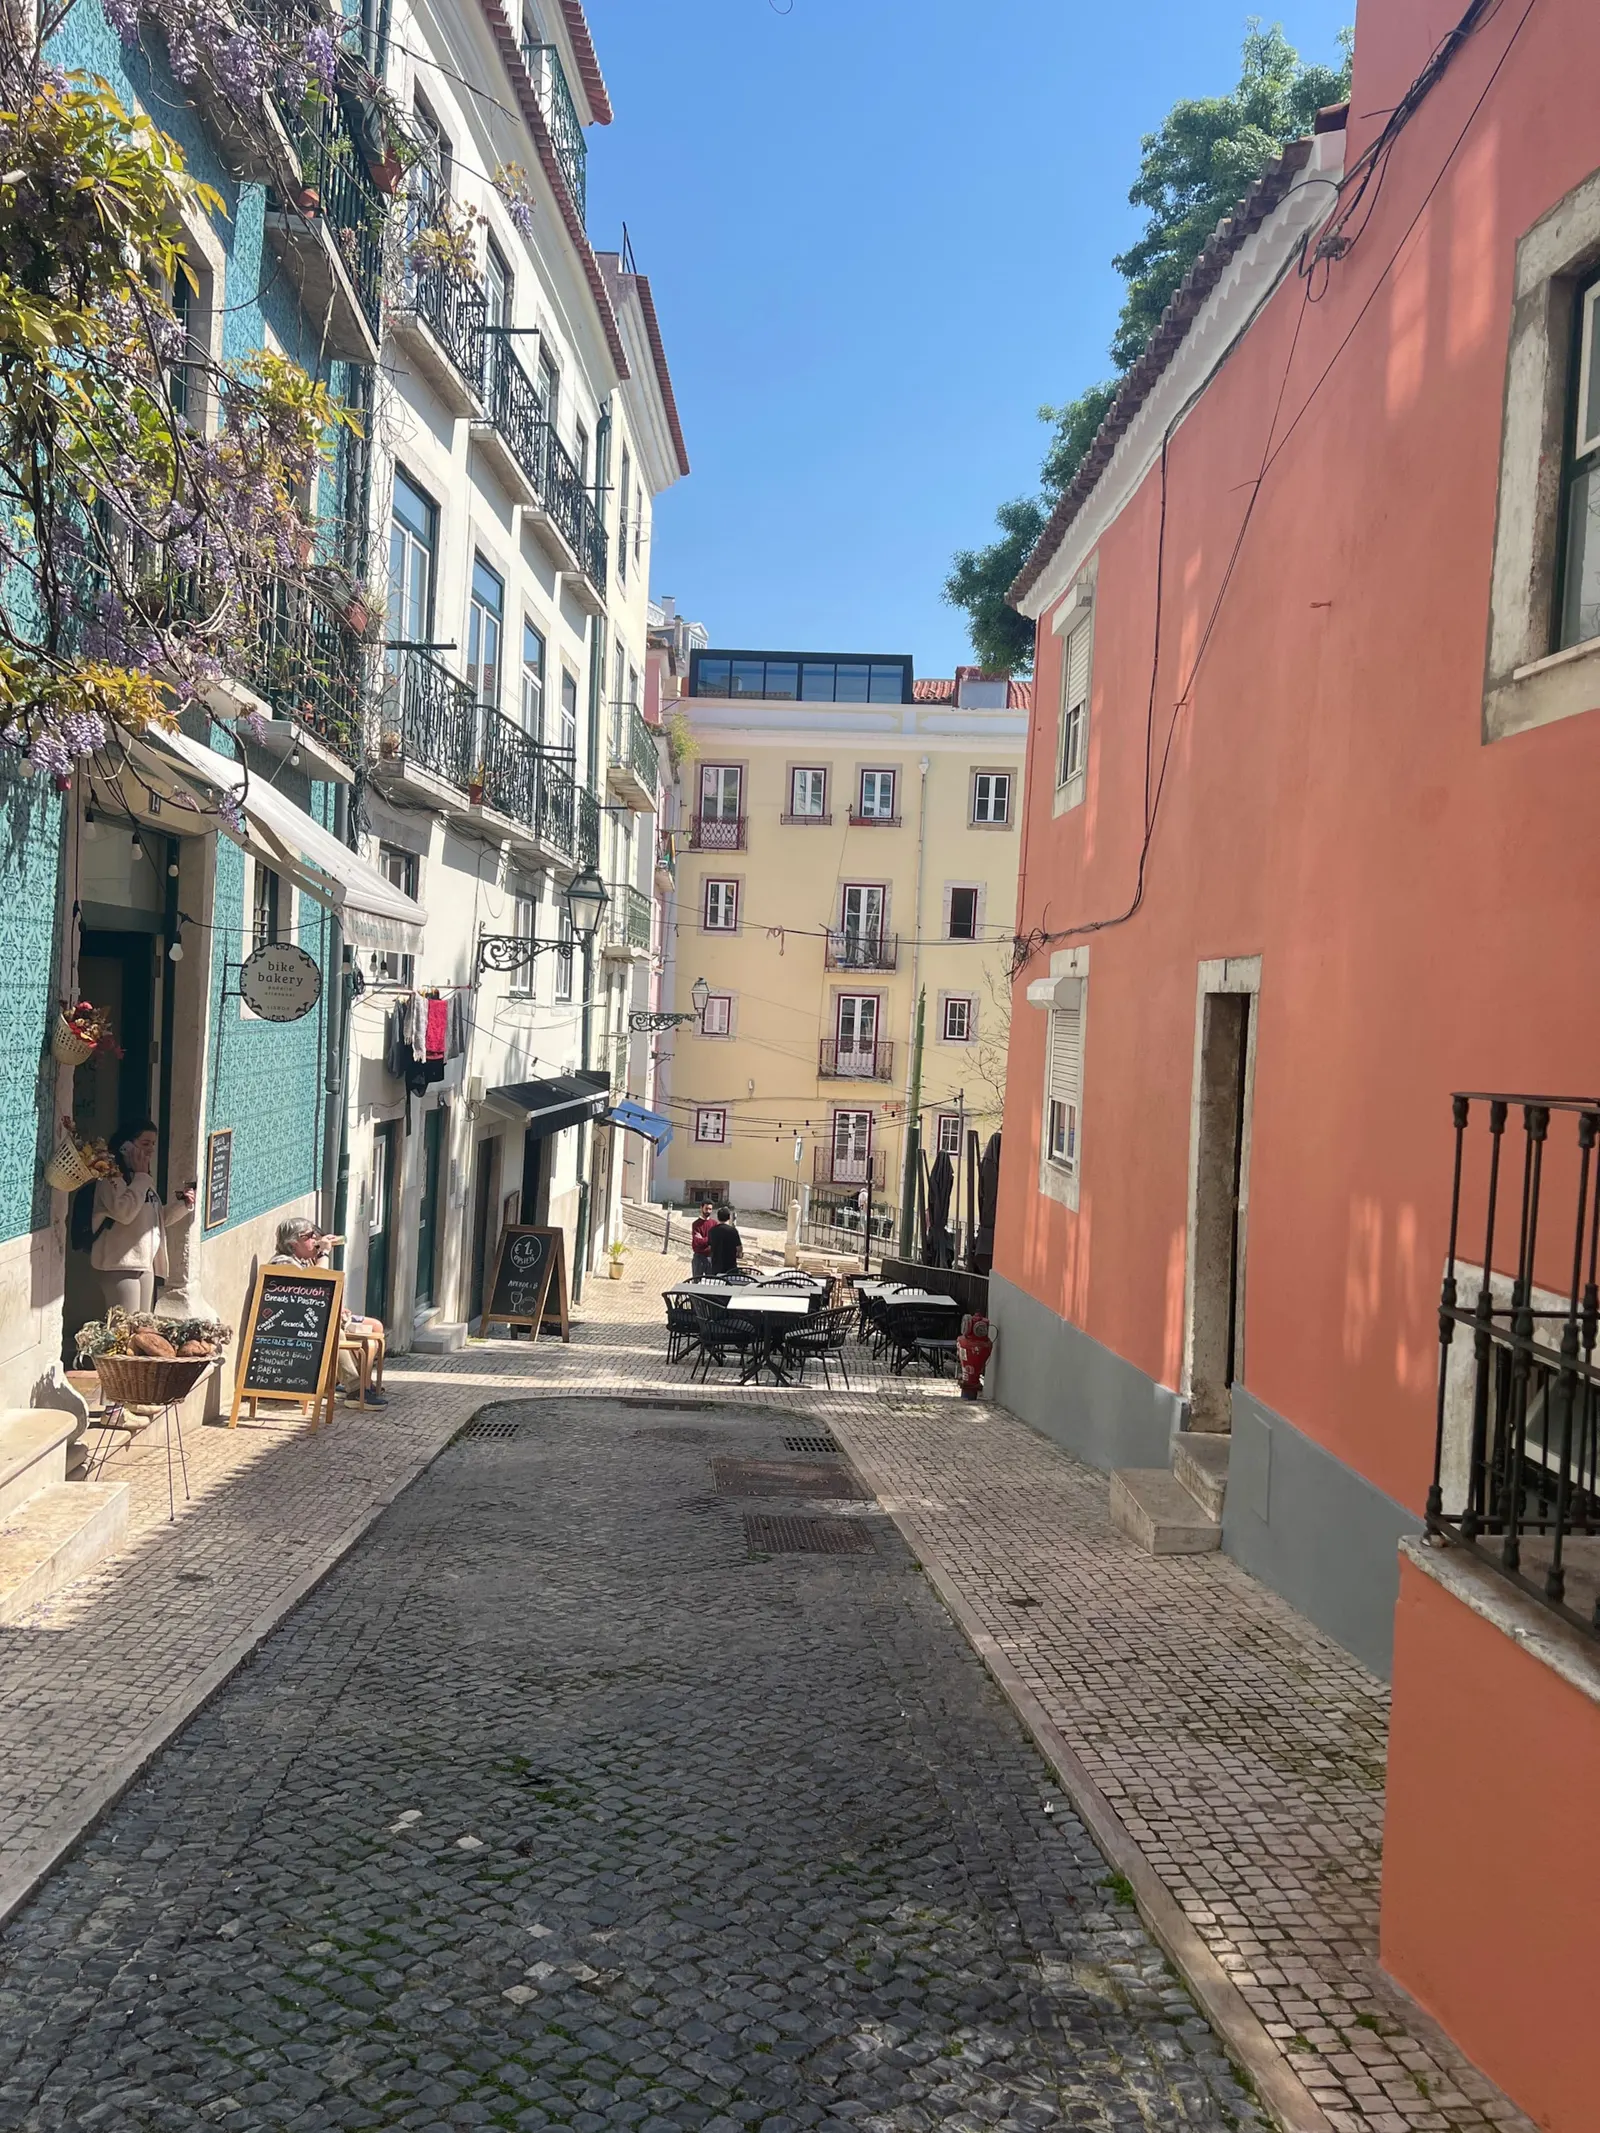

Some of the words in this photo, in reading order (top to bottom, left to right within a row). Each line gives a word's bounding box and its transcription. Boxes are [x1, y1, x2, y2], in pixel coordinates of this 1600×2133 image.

[268, 960, 295, 972] bike
[258, 972, 303, 987] bakery
[266, 1280, 325, 1297] Sourdough
[264, 1293, 289, 1303] Breads
